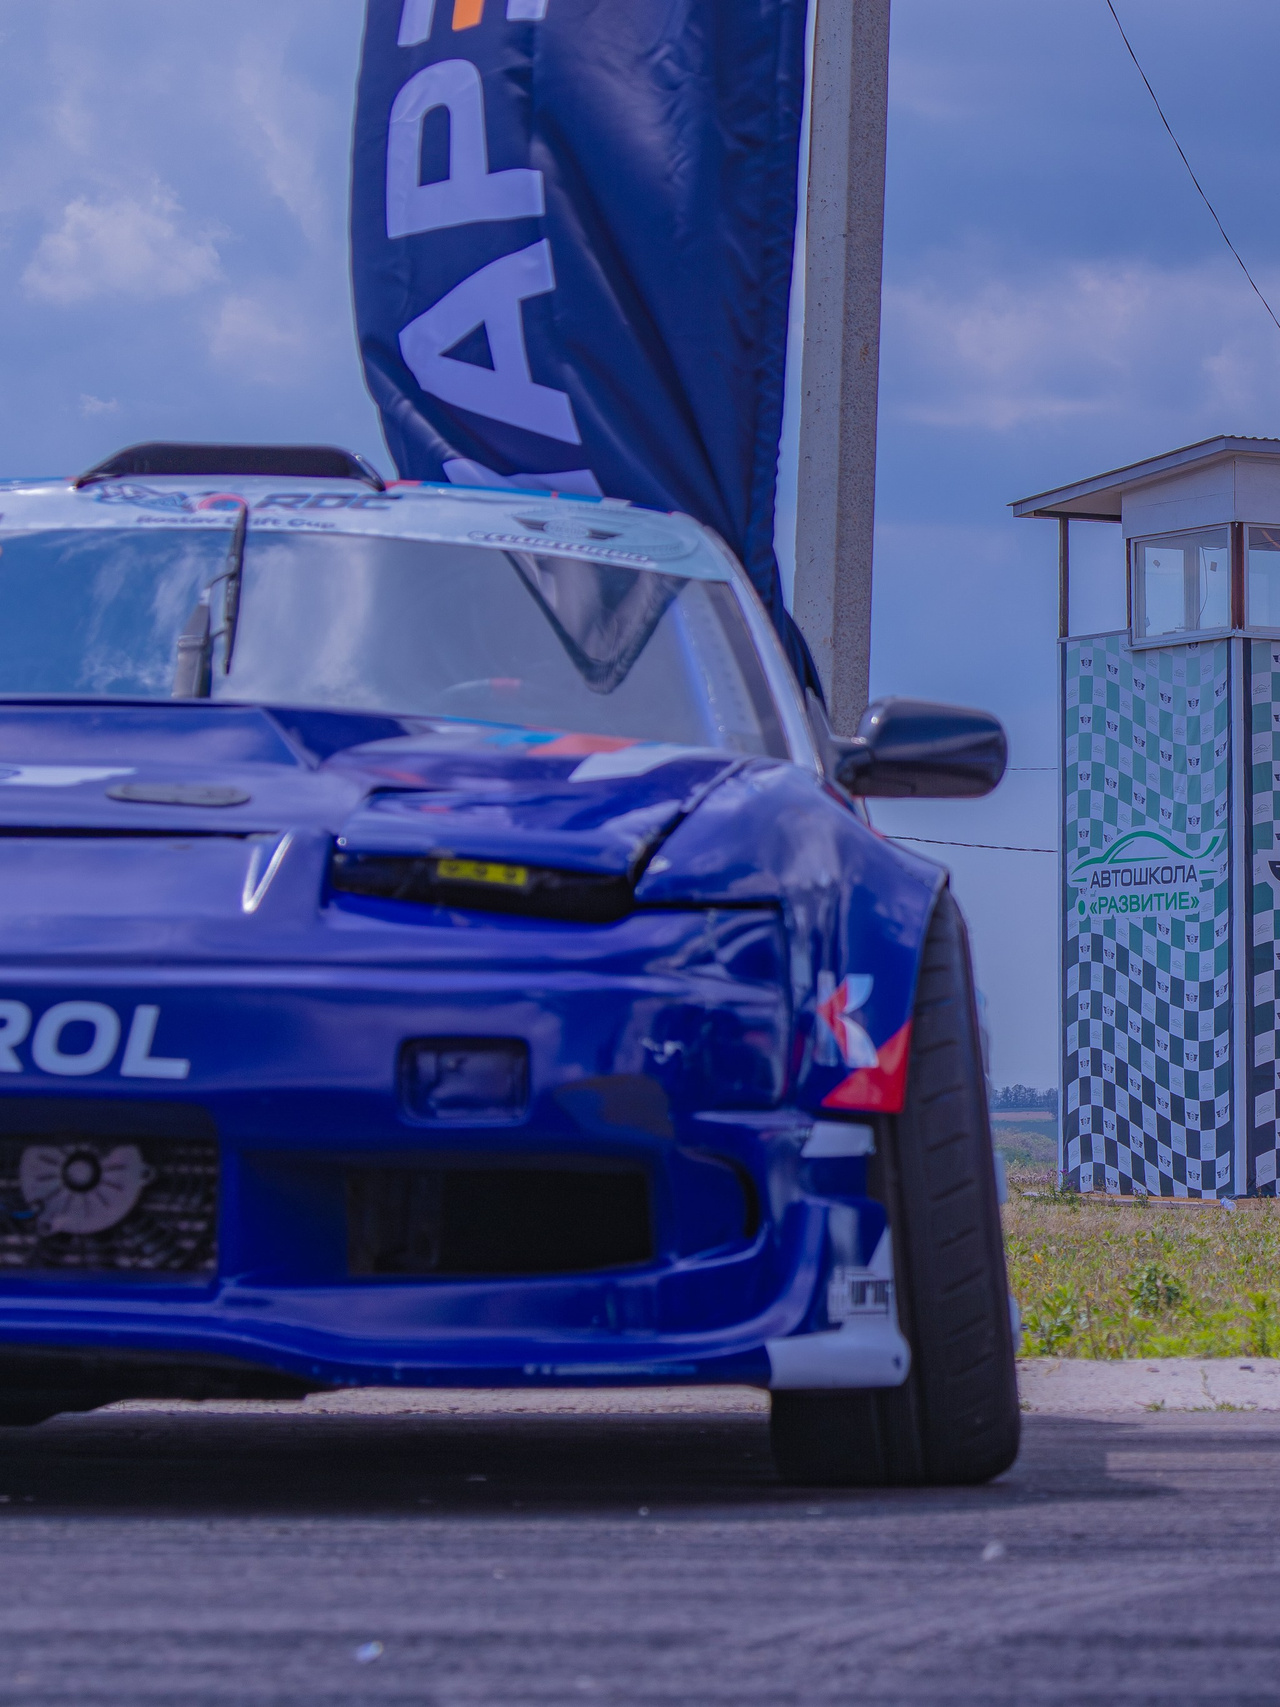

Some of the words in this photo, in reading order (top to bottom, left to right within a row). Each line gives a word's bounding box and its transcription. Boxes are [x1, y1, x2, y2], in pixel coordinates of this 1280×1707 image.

[225, 515, 282, 528] Dift
[1090, 864, 1197, 889] АВТОШКОЛА
[1089, 891, 1200, 915] «РАЗВИТИЕ»
